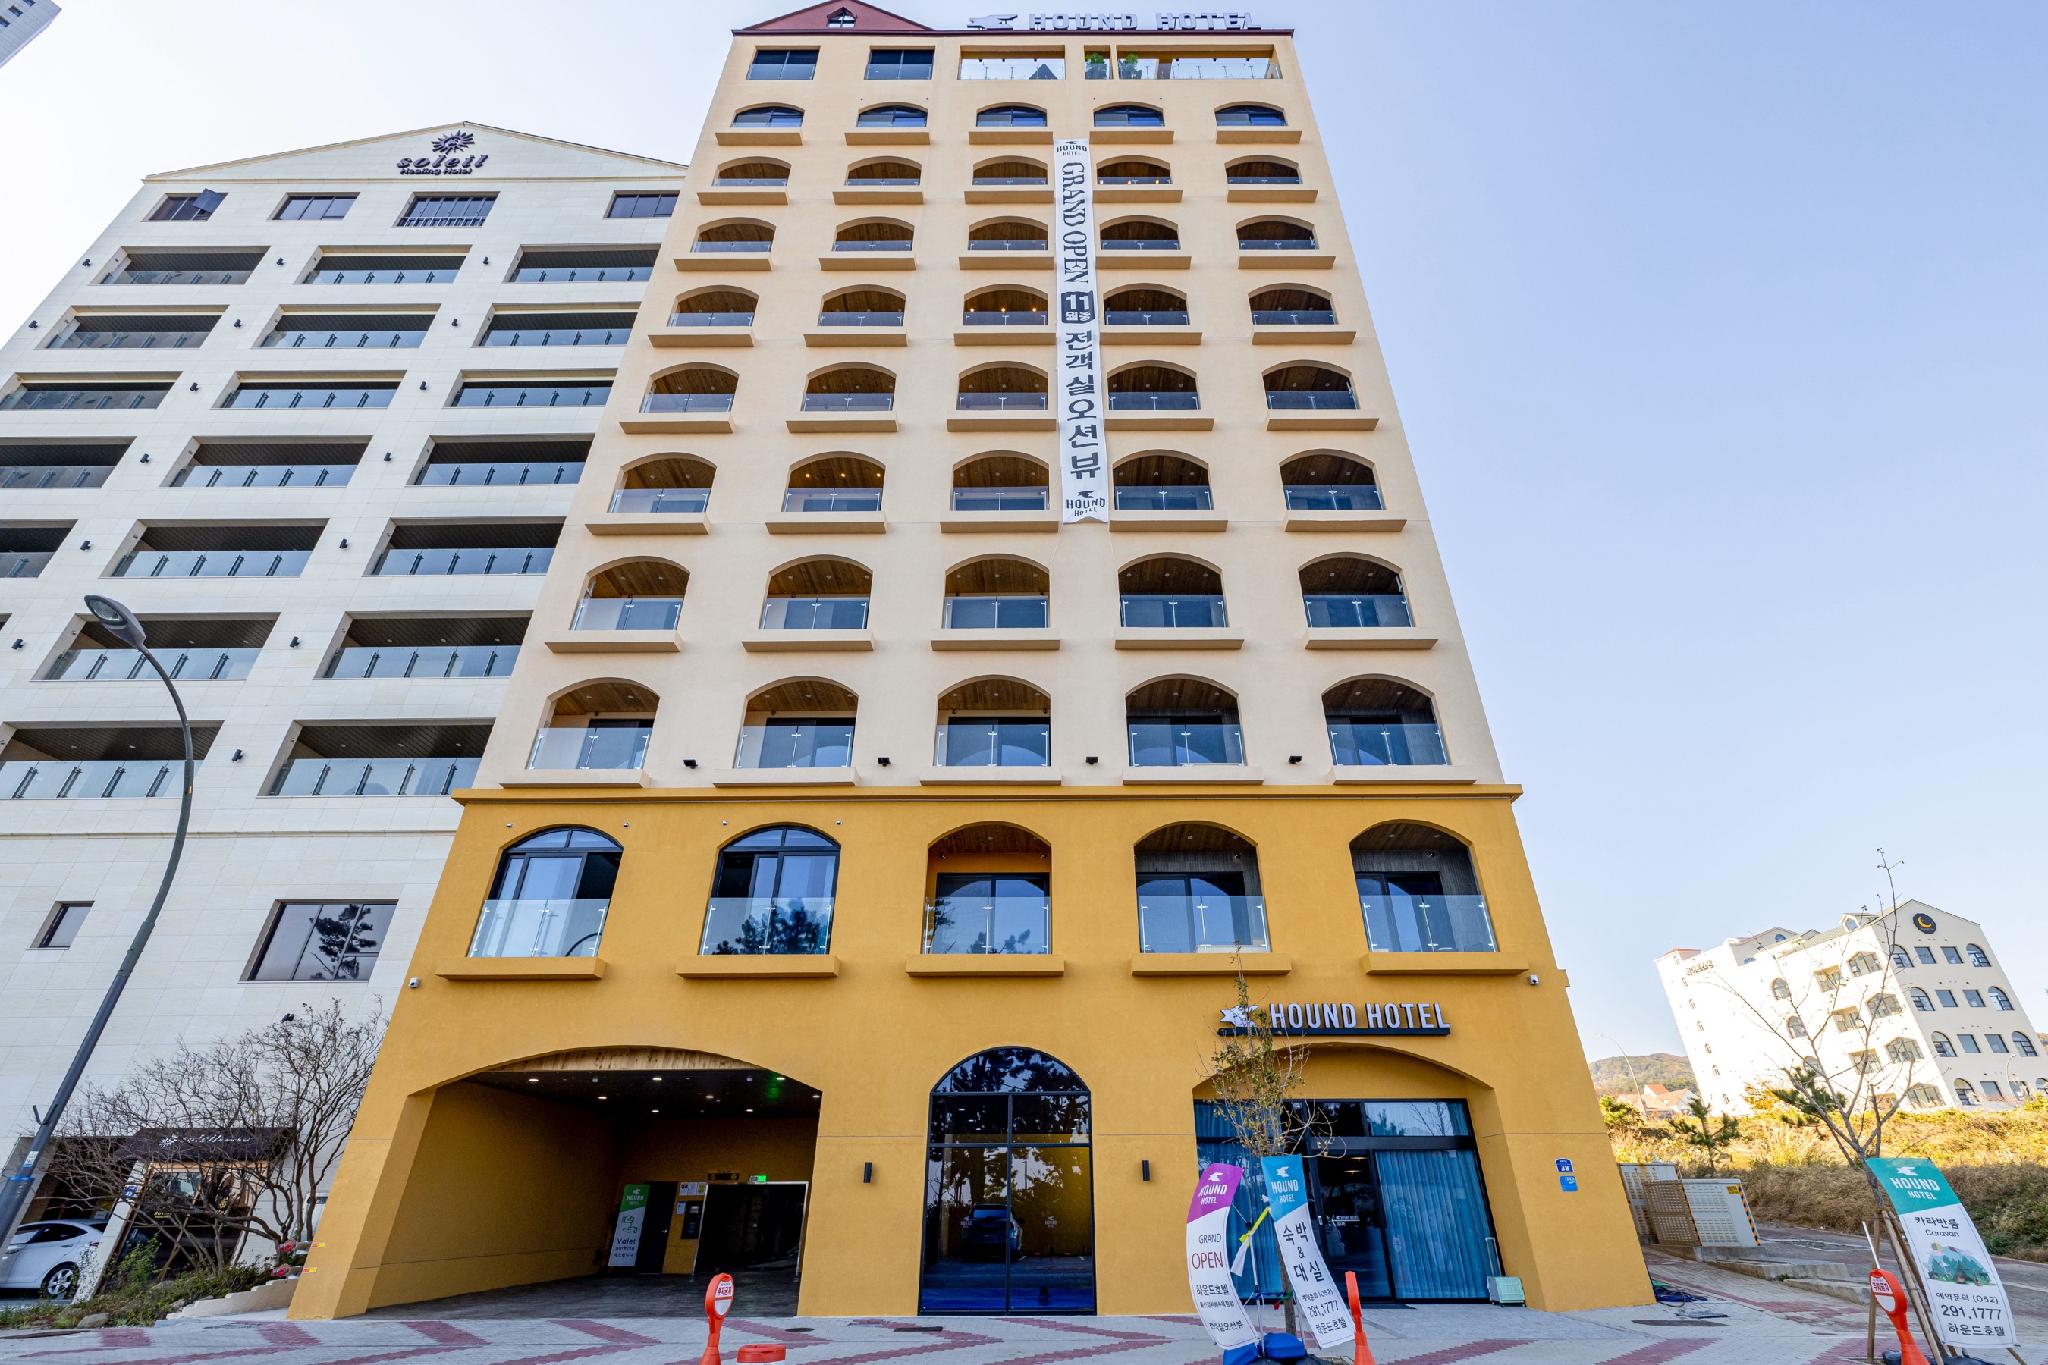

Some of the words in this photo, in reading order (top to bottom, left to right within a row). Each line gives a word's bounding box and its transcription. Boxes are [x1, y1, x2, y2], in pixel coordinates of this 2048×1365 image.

[1029, 13, 1138, 31] HOUND
[1156, 12, 1262, 31] HOTEL
[1056, 145, 1088, 153] HOUND
[397, 154, 489, 169] soleil
[1062, 162, 1085, 227] GRAND
[1063, 231, 1088, 284] OPEN
[1065, 294, 1089, 310] 11
[1066, 498, 1106, 509] HOUND
[1269, 1003, 1357, 1029] HOUND
[1367, 1003, 1451, 1029] HOTEL
[1198, 1184, 1228, 1197] HOUND
[1270, 1180, 1299, 1194] HOUND
[1889, 1177, 1941, 1191] HOUND
[1200, 1196, 1217, 1205] HOTEL
[1907, 1190, 1937, 1200] HOTEL
[1914, 1216, 1959, 1230] 카라반룸
[1198, 1233, 1222, 1244] GRAND
[1283, 1222, 1309, 1245] 숙박
[1191, 1251, 1224, 1270] OPEN
[1293, 1260, 1324, 1282] 대실
[1941, 1304, 2002, 1320] 291.1777
[1946, 1322, 2006, 1337] 하운드호텔
